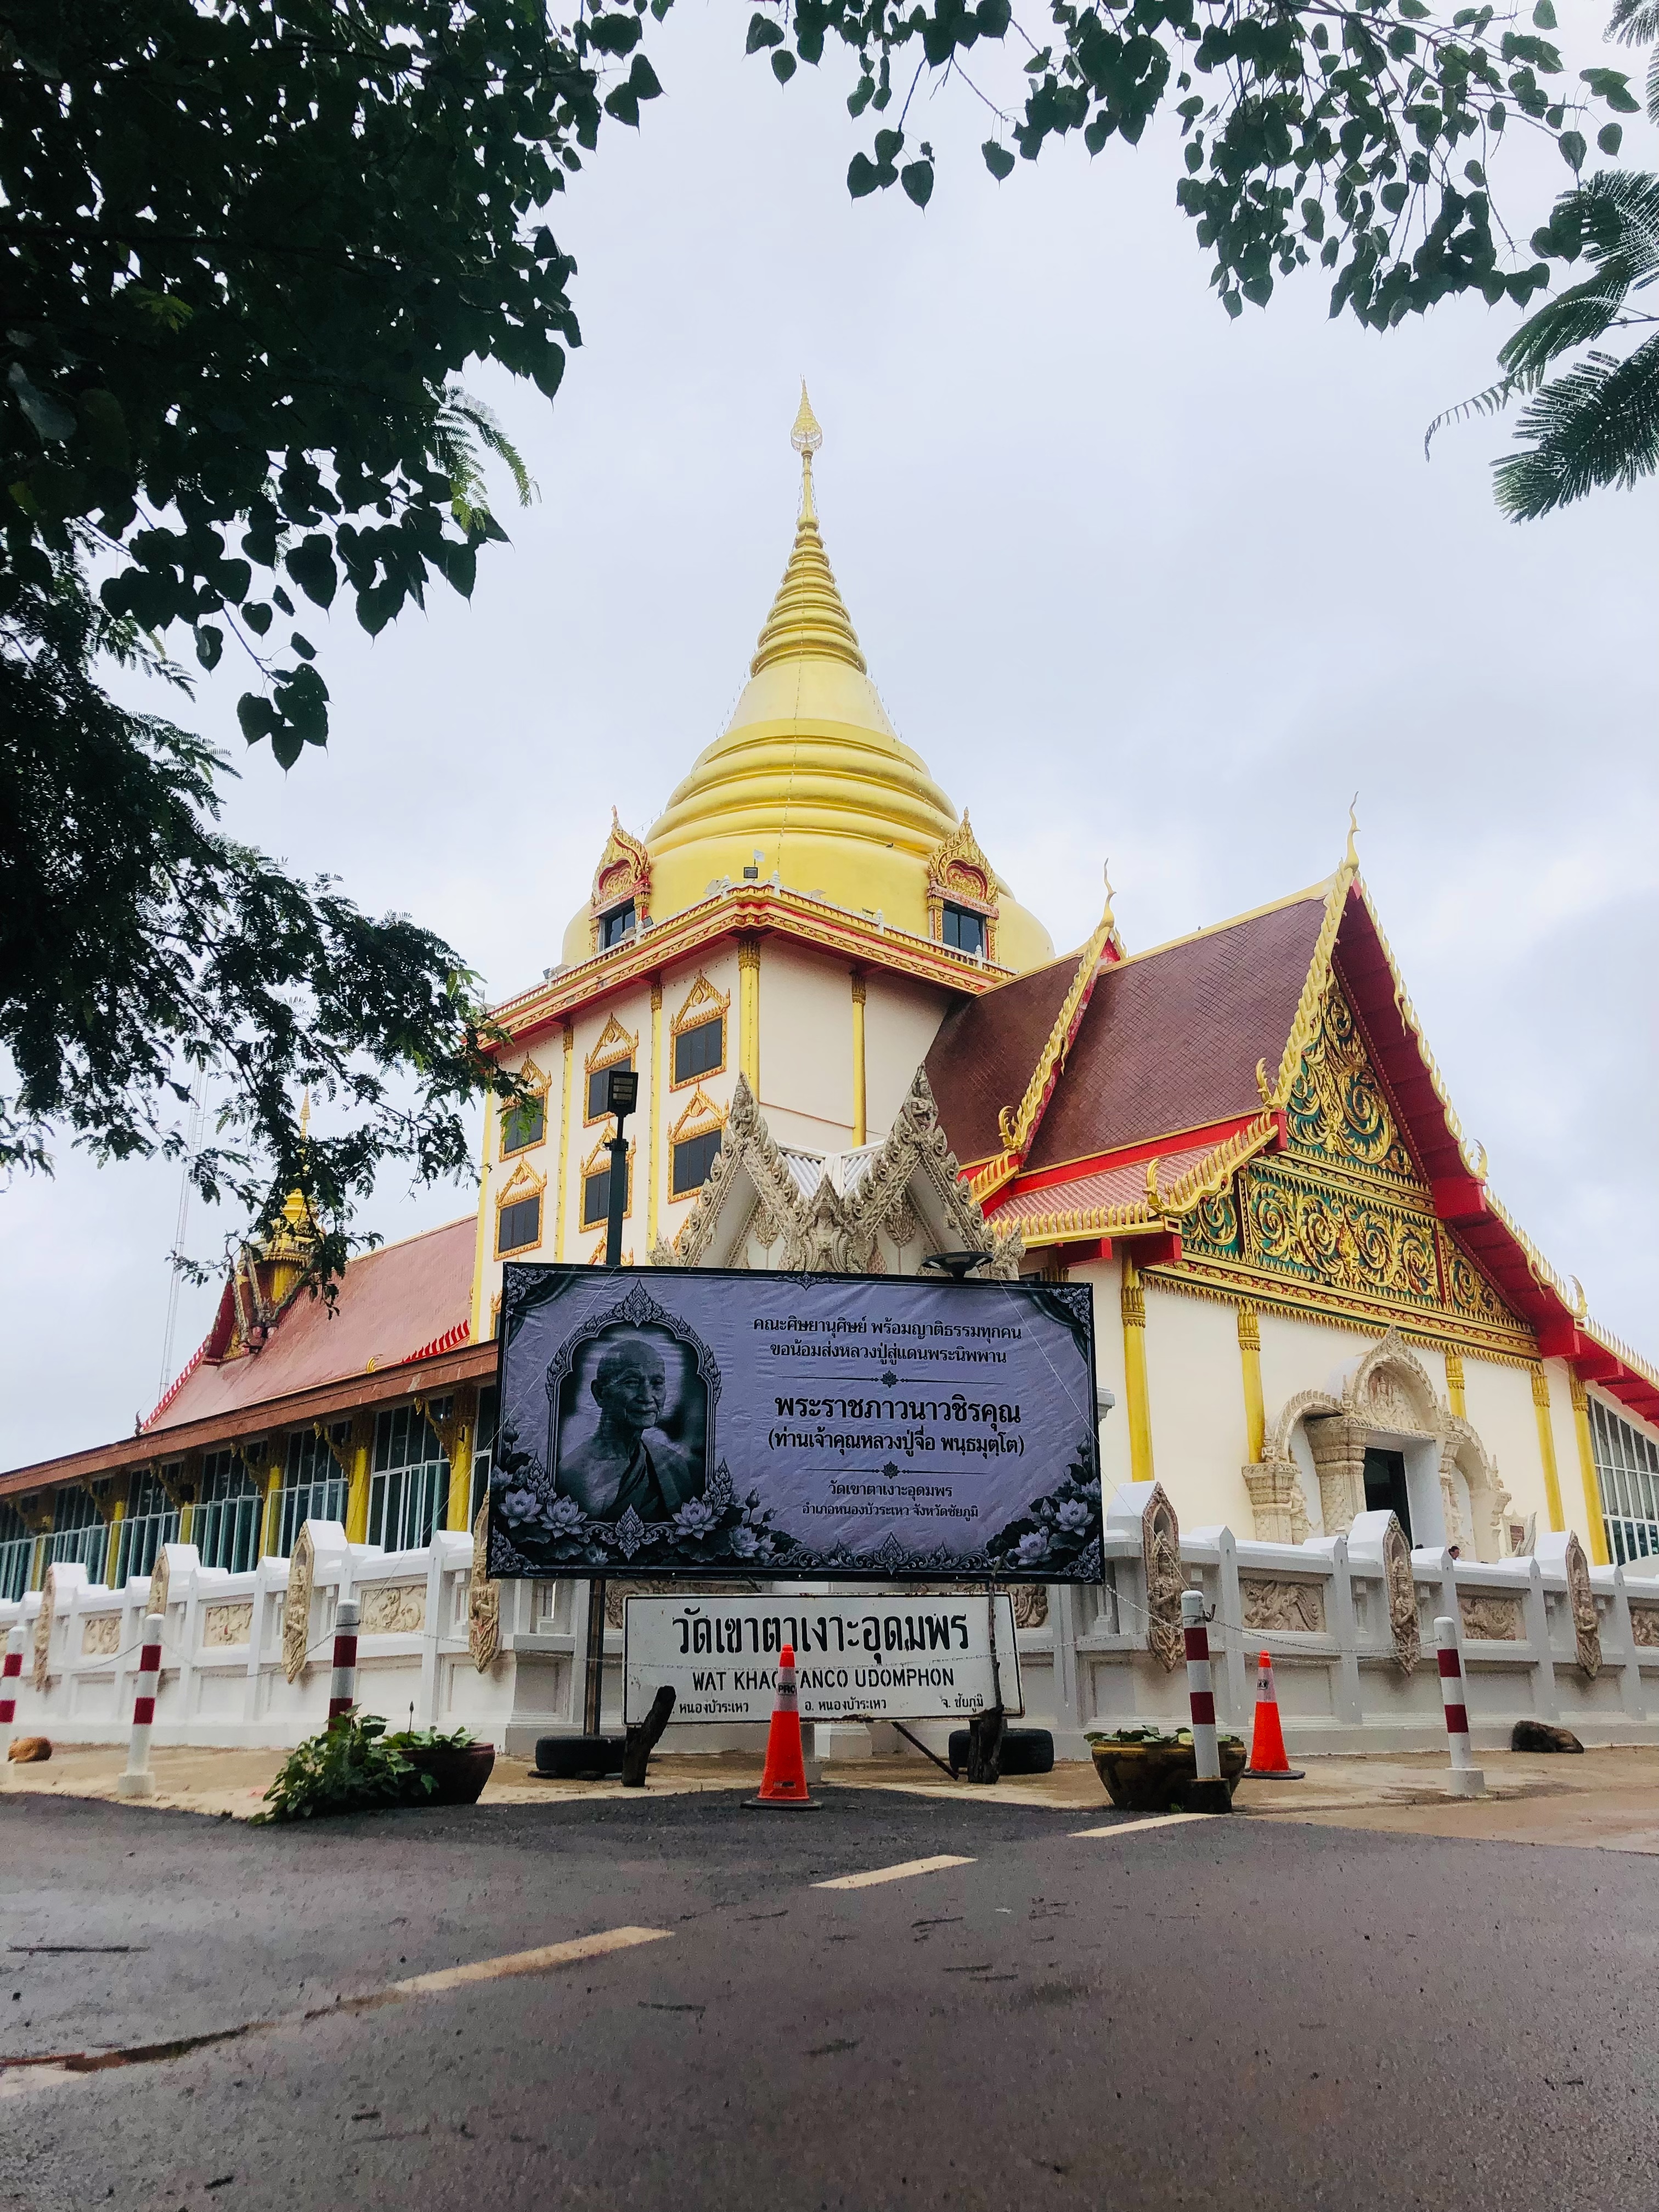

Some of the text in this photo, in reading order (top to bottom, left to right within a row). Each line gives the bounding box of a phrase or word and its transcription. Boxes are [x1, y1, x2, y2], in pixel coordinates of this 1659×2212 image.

[754, 1315, 1022, 1344] คณะศิษยานุศิษย์ พร้อมญาติธรรมทุกคน
[770, 1339, 1007, 1365] ขอน้อมส่งหลวงปู่สู่แดนพระนิพพาน
[775, 1394, 1022, 1431] พระราชภาวนาวชิรคุณ
[828, 1480, 952, 1501] วัดเขาตาเงาะอุดมพร
[802, 1502, 979, 1521] อำเภอหนองบัวระเหว จังหวัดชัยภูมิ
[673, 1607, 968, 1663] วัดเขาตาเงาะอุดมพร
[692, 1672, 726, 1691] WAT
[795, 1669, 848, 1689] ANCO
[855, 1668, 954, 1688] UDOMPHON
[679, 1692, 984, 1713] หนองบัวระเหว อ. หนองบัวระเหว จ. ชัยภูมิ
